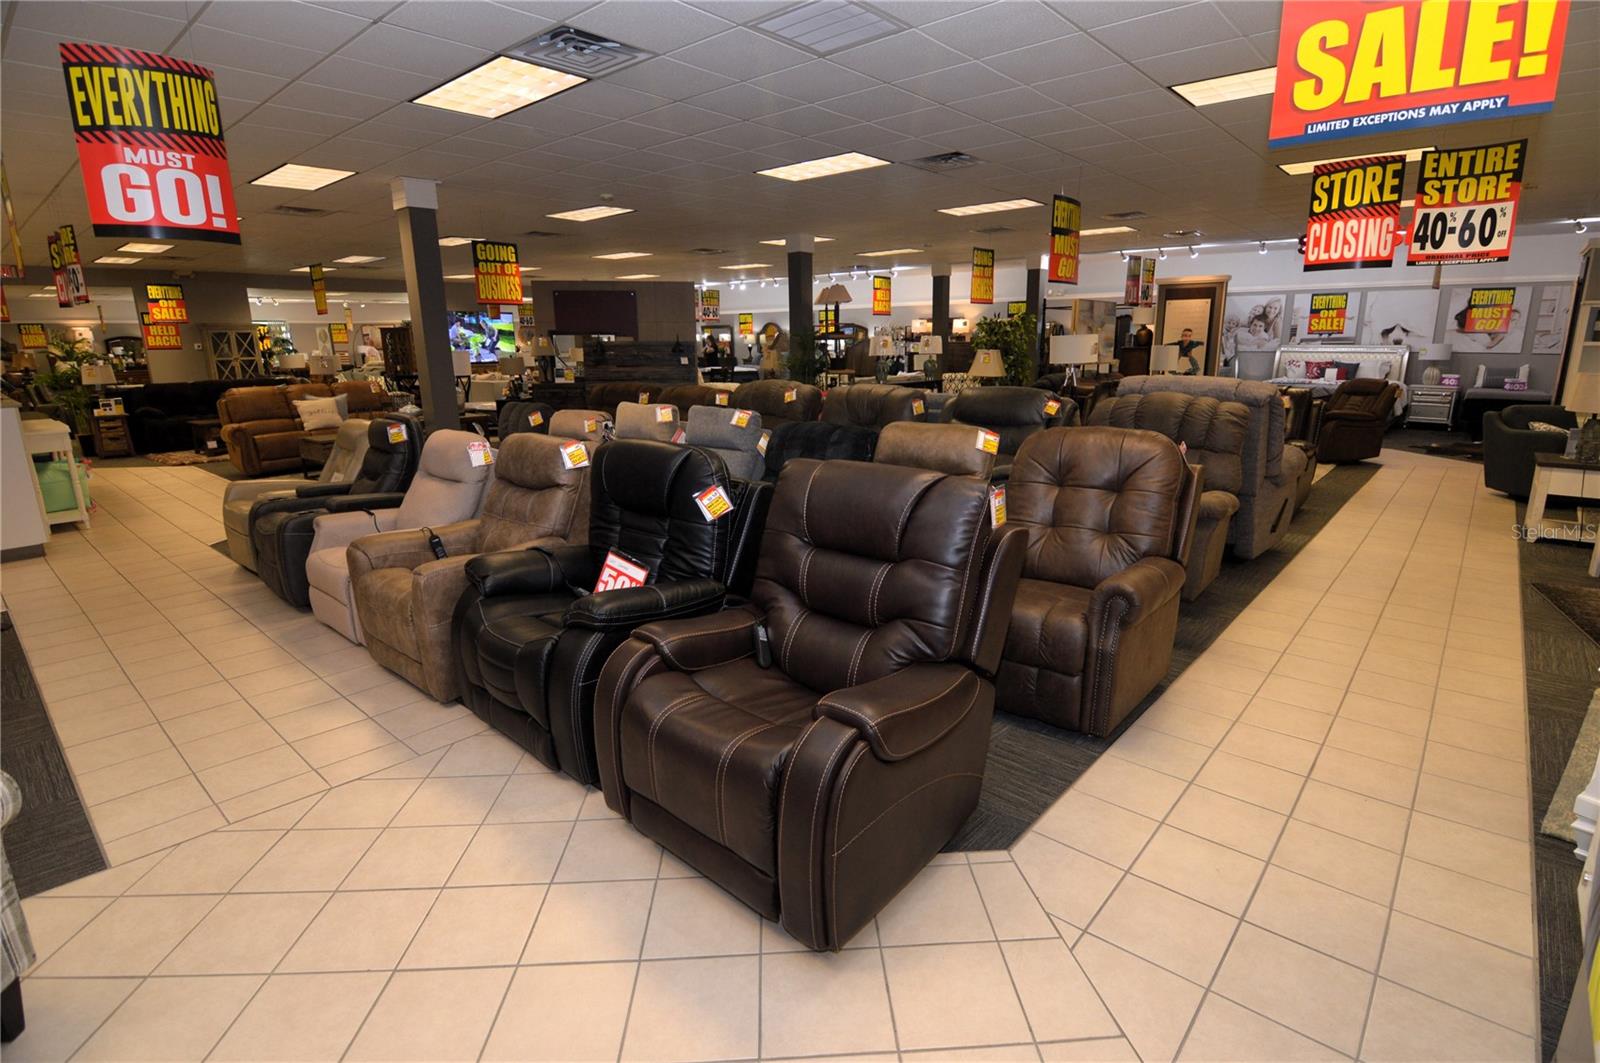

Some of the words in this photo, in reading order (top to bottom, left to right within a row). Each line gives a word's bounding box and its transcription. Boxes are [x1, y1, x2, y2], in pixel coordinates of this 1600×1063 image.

[1293, 0, 1557, 111] SALE!
[69, 67, 219, 136] EVERYTHING
[1307, 120, 1350, 134] LIMITED
[1352, 107, 1426, 127] EXCEPTIONS
[1429, 103, 1459, 117] MAY
[1462, 97, 1505, 112] APPLY
[123, 147, 195, 169] MUST
[1424, 143, 1521, 178] ENTIRE
[101, 163, 227, 228] GO!
[1313, 163, 1402, 213] STORE
[1423, 173, 1513, 205] STORE
[1308, 217, 1394, 261] CLOSING
[476, 243, 516, 262] GOING
[479, 261, 501, 273] OUT
[504, 263, 517, 274] OF
[479, 275, 521, 300] BUSINESS
[1472, 289, 1514, 305] EVERYTHING
[1312, 294, 1347, 310] EVERYTHING
[152, 307, 187, 320] SALE!
[1319, 310, 1336, 318] ON
[1471, 307, 1510, 319] MUST
[150, 326, 176, 335] HELD
[1310, 317, 1344, 331] SALE!
[1475, 319, 1504, 331] GO!
[147, 336, 181, 346] BACK!
